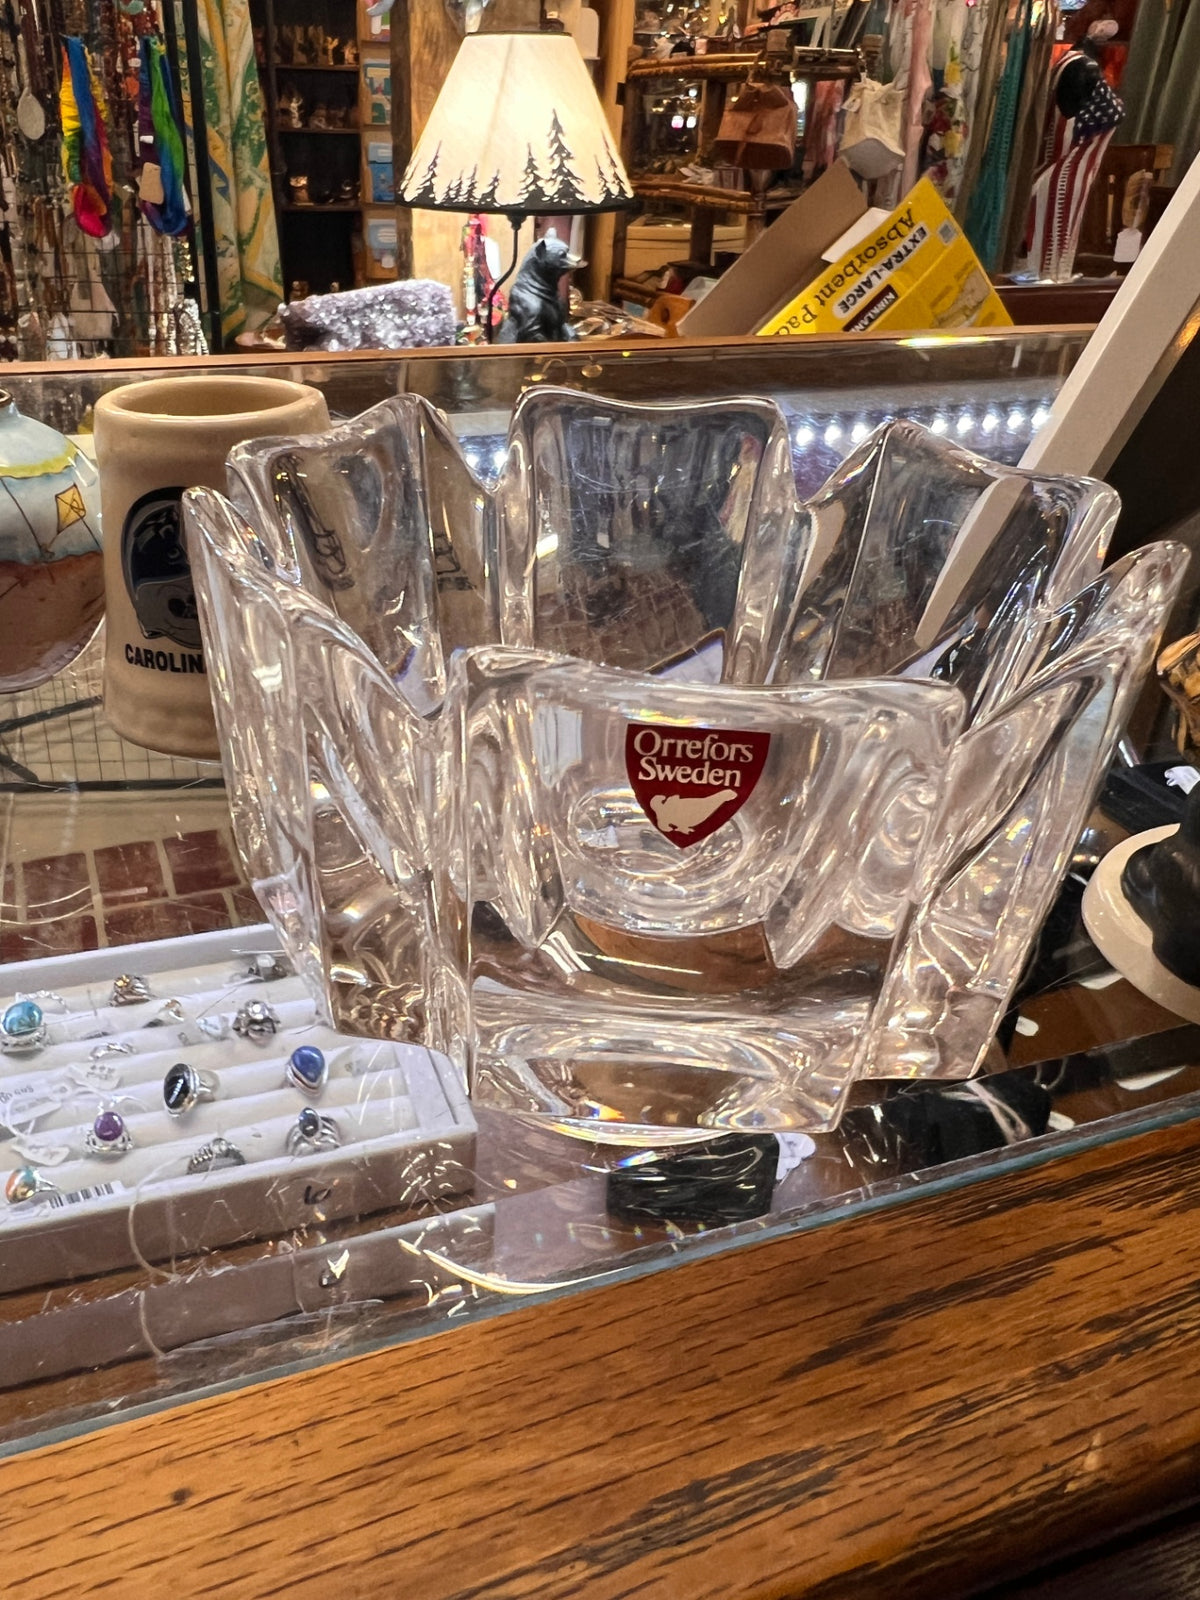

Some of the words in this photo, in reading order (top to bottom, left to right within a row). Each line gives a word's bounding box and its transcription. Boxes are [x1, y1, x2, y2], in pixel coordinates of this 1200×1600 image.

[814, 208, 915, 307] Absorbent
[838, 226, 927, 313] EXTRA-LARGE
[125, 643, 208, 674] CAROLIN
[633, 729, 754, 763] Orrefors
[638, 756, 742, 787] Sweden
